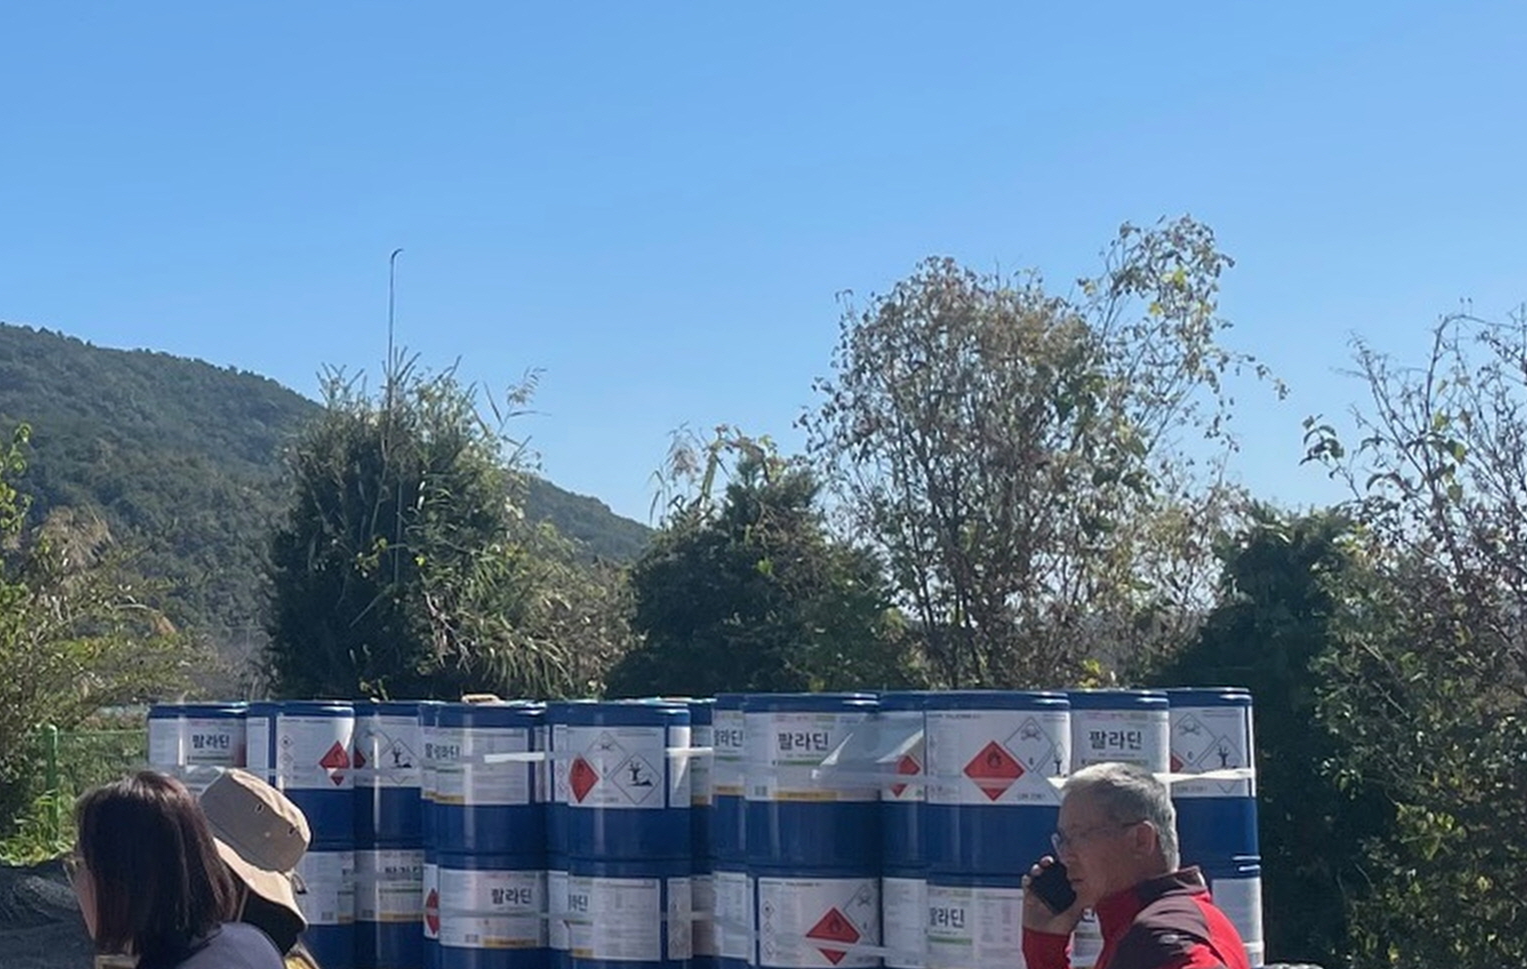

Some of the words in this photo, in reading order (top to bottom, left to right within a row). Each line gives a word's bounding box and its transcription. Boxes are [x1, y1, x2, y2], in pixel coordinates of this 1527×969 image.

[192, 732, 231, 750] 팔라딘
[778, 731, 829, 751] 팔라딘
[1089, 730, 1143, 751] 팔라딘
[491, 887, 533, 905] 팔라딘
